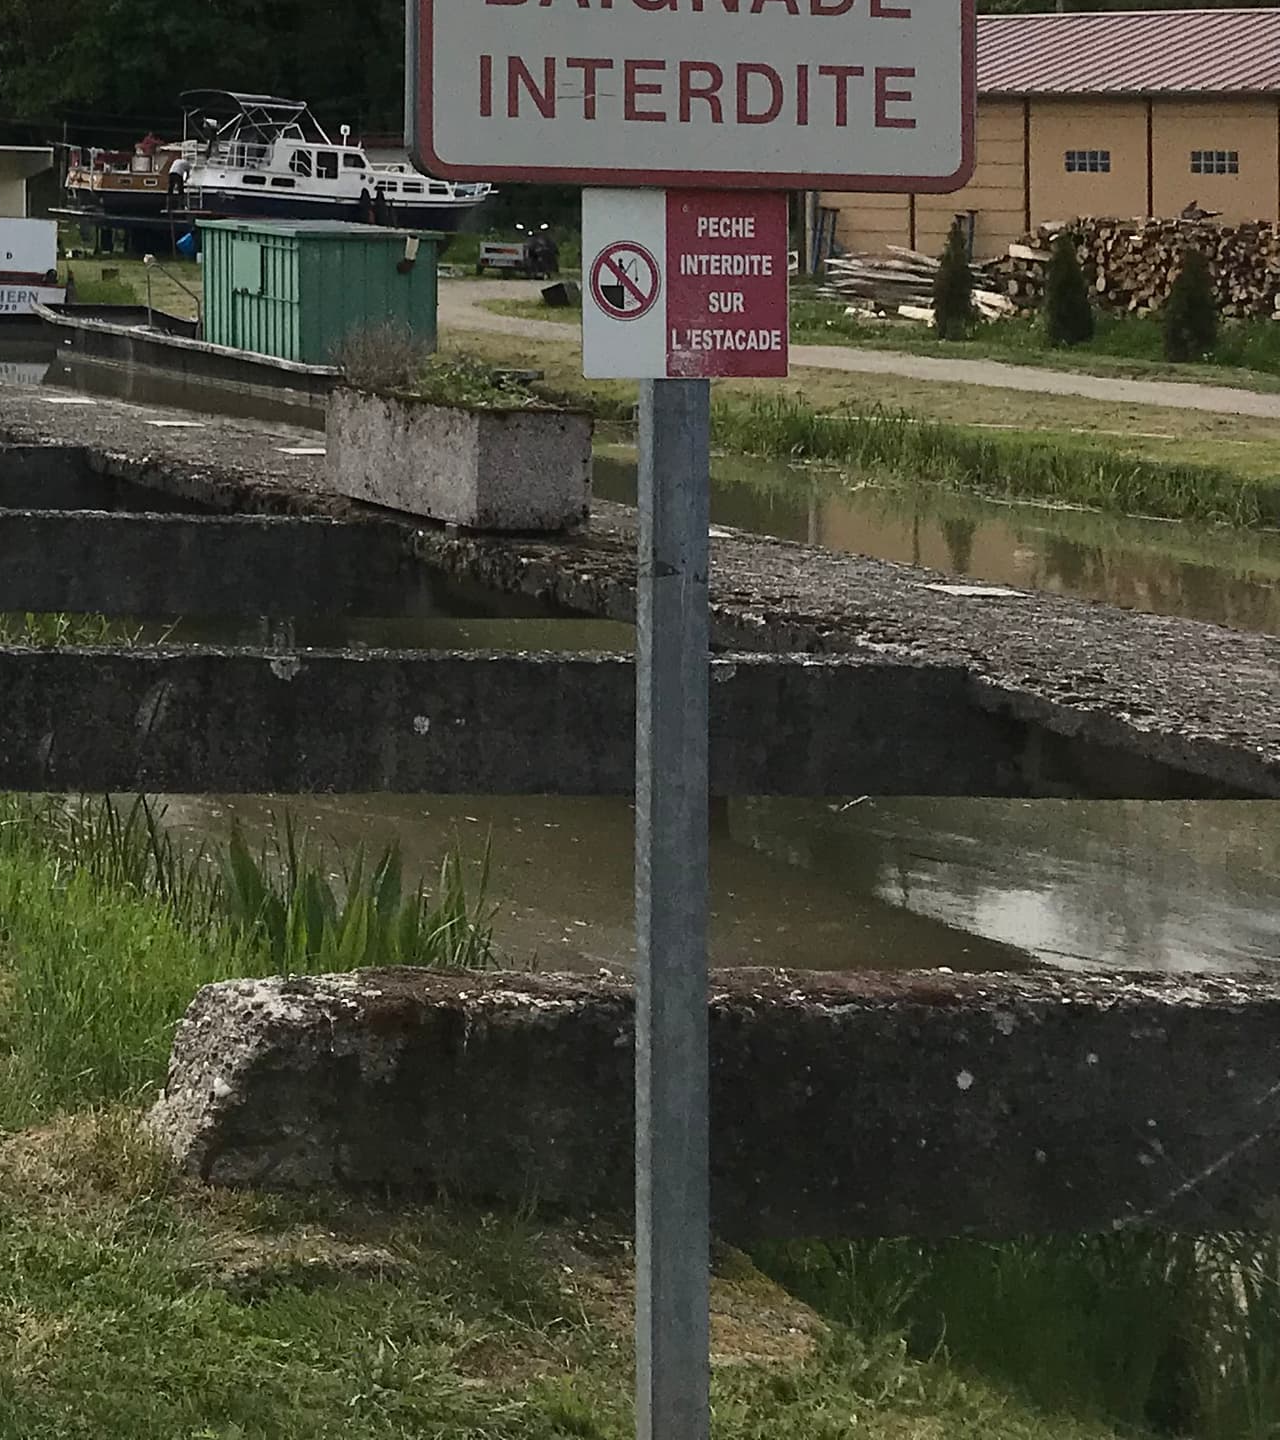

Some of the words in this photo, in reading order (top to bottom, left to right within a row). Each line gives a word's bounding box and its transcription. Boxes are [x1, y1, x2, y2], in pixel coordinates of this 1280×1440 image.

[479, 54, 917, 129] INTERDITE
[697, 217, 755, 238] PECHE
[680, 254, 773, 276] INTERDITE
[708, 291, 745, 313] SUR
